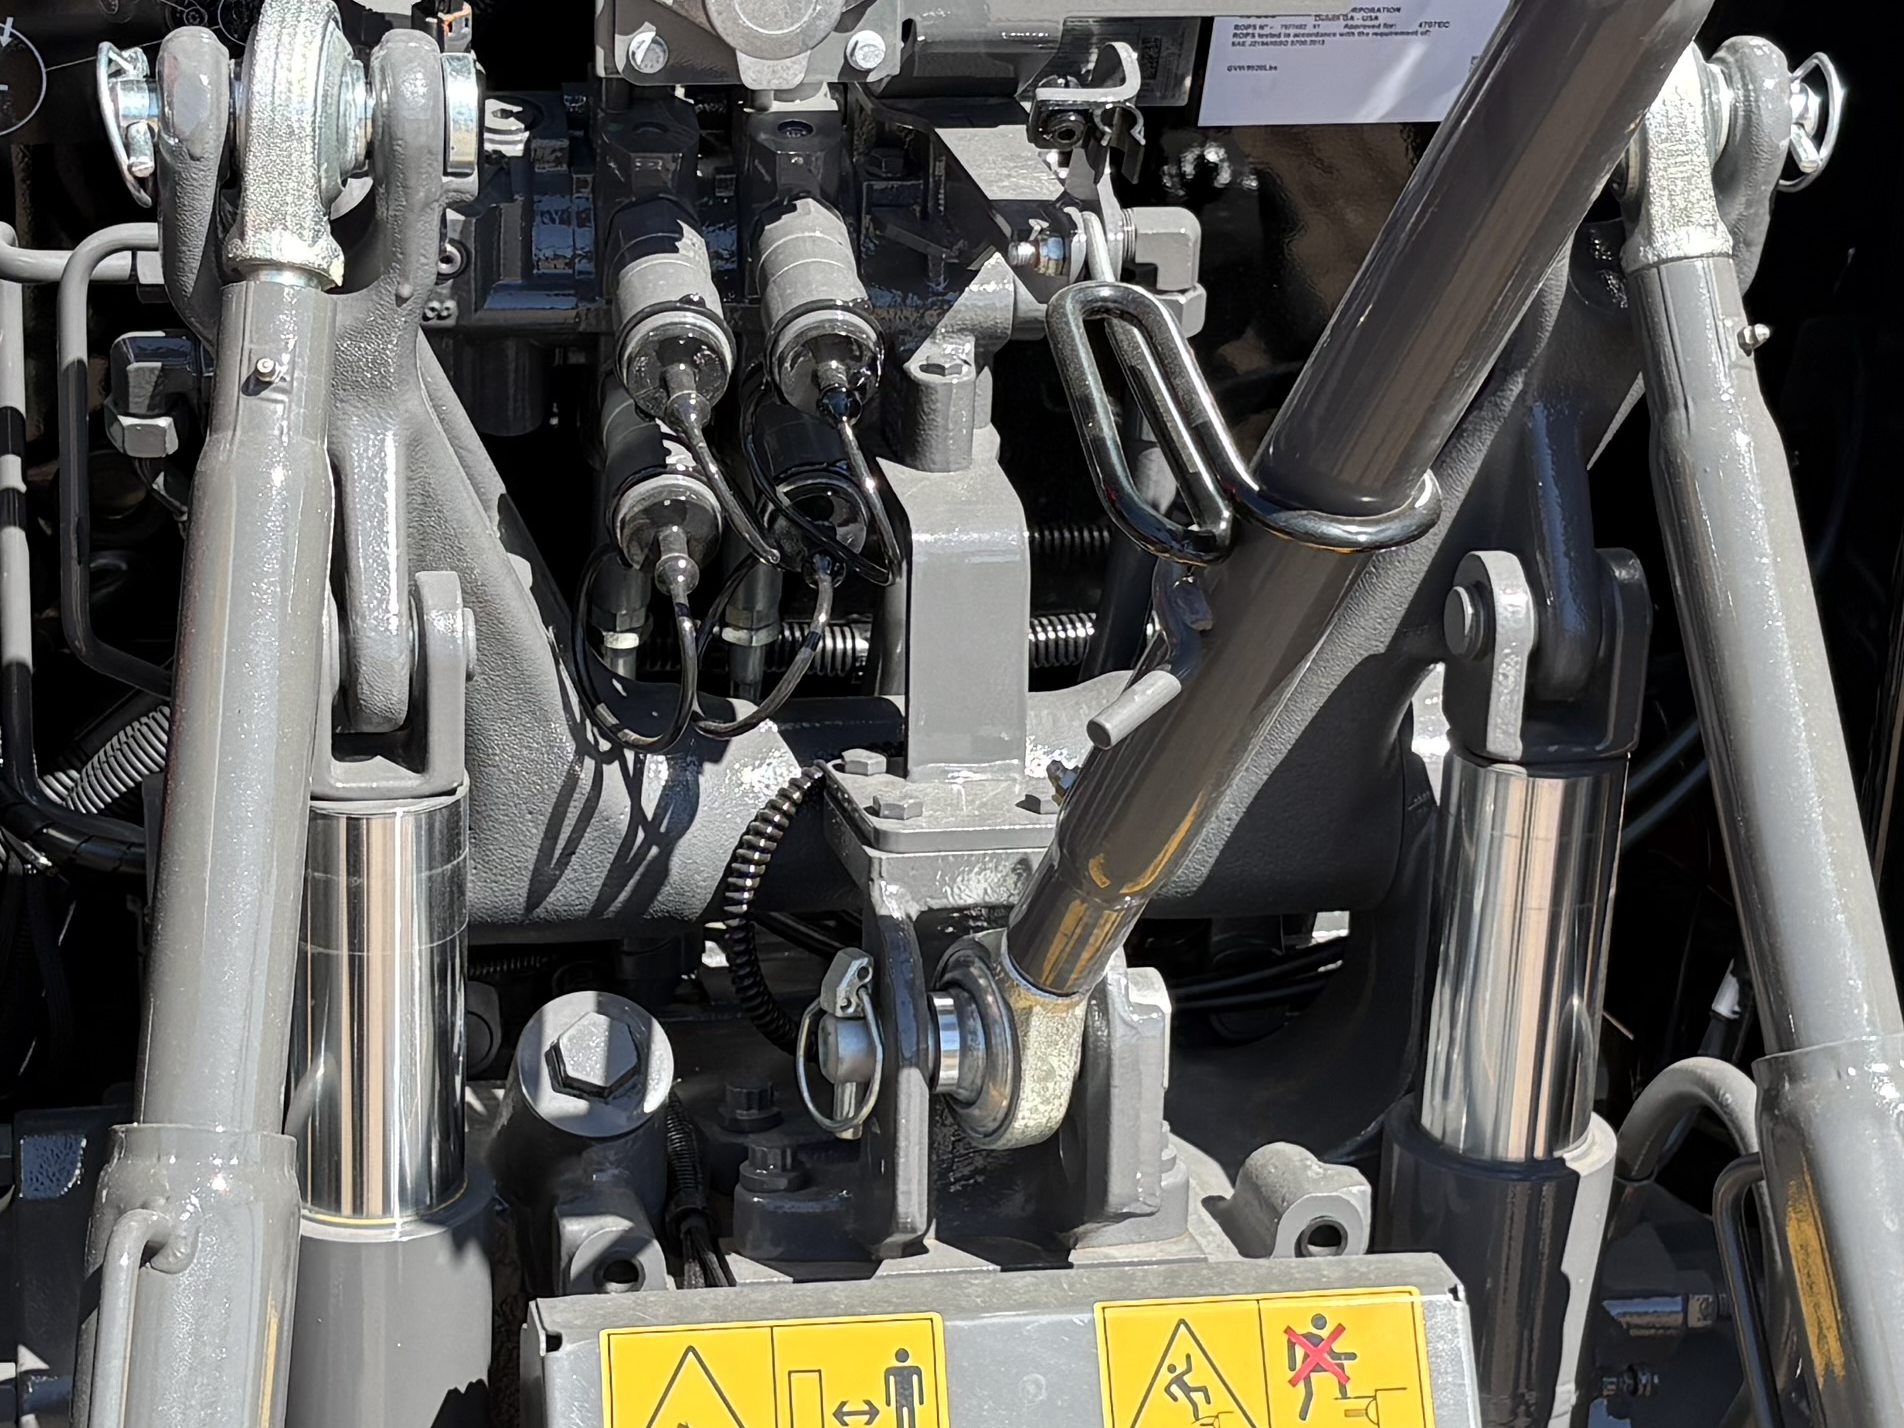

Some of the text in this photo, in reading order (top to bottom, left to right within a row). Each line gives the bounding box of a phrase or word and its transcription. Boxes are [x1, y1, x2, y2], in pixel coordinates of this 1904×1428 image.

[1361, 14, 1379, 22] USA
[1343, 22, 1381, 30] Approved
[1292, 31, 1337, 39] accordance
[1338, 30, 1356, 38] with
[1357, 30, 1370, 38] the
[1371, 30, 1418, 39] requirement
